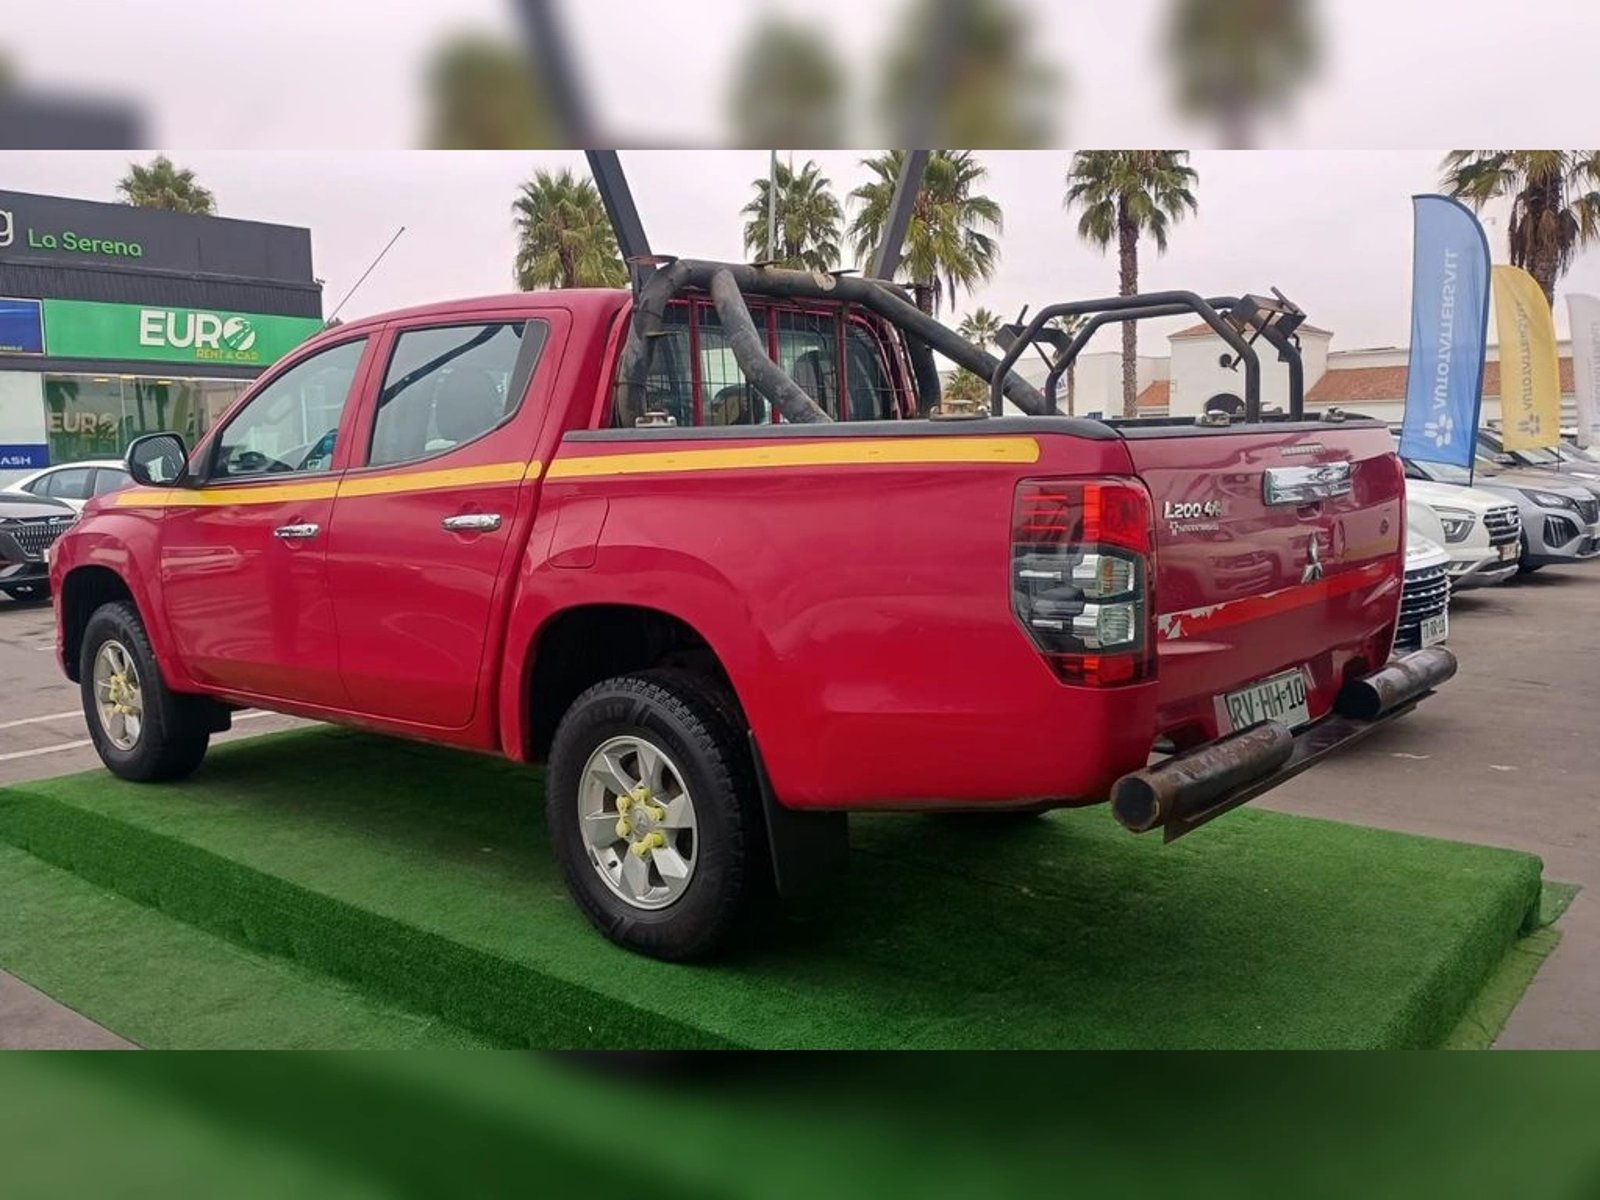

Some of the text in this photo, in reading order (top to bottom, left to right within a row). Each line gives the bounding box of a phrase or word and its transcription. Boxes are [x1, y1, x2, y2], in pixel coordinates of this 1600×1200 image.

[28, 228, 142, 256] La Serena
[140, 309, 256, 351] EURO
[196, 349, 223, 359] RENT
[1164, 501, 1201, 518] L200
